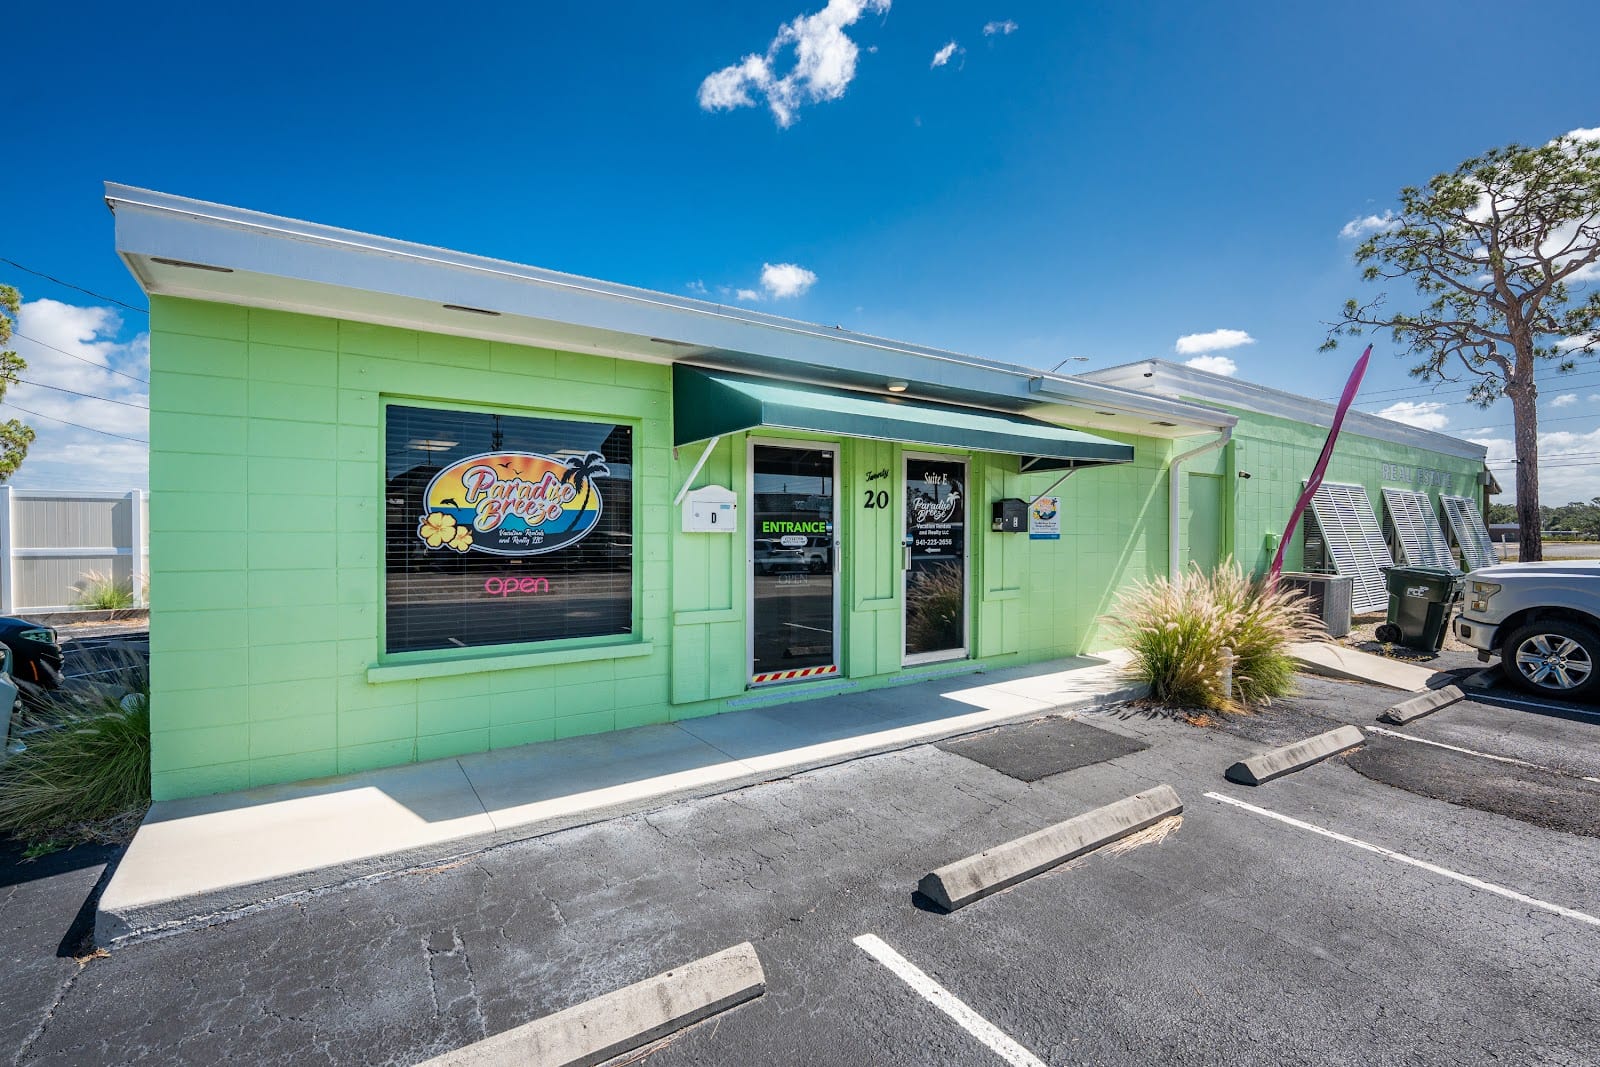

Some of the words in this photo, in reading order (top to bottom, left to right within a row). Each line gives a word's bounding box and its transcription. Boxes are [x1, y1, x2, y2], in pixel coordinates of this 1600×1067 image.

[924, 472, 941, 485] Suite
[943, 473, 948, 486] E
[1382, 463, 1413, 484] REAL
[466, 468, 576, 503] Paradise
[864, 490, 889, 509] 20
[913, 497, 952, 512] Paradise
[478, 499, 562, 531] Breeze
[711, 512, 717, 524] D
[917, 508, 947, 523] Breeze
[762, 521, 826, 533] ENTRANCE
[512, 536, 530, 546] Realty
[484, 576, 549, 596] open
